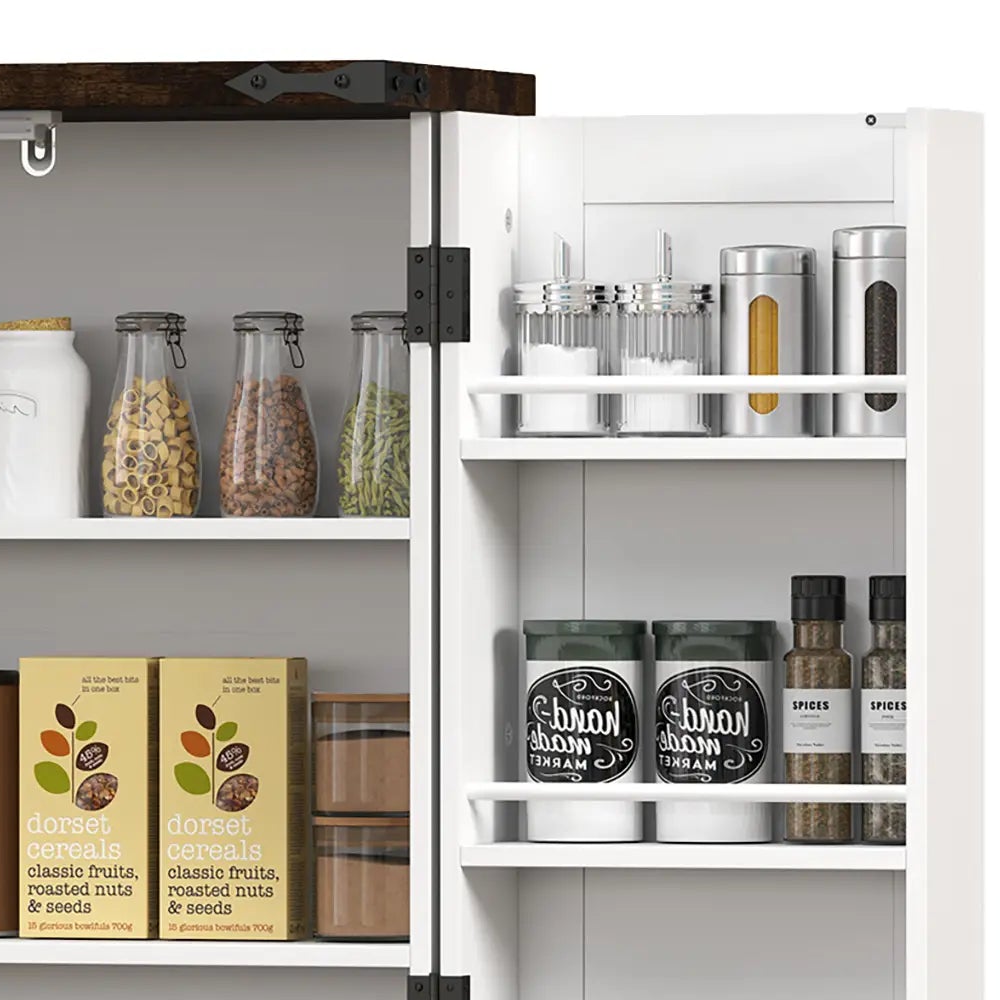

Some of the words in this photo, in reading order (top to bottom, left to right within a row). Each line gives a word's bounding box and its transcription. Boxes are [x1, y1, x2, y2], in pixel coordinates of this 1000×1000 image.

[82, 676, 92, 684] all
[93, 676, 106, 684] the
[108, 676, 123, 684] best
[124, 676, 140, 684] bits
[222, 686, 230, 694] in
[232, 686, 246, 694] one
[247, 686, 261, 694] box
[792, 700, 830, 711] SPICES
[870, 700, 906, 711] SPICES
[26, 812, 112, 834] dorset
[167, 814, 252, 836] dorset
[26, 838, 122, 860] cereals
[167, 840, 262, 861] cereals
[28, 864, 84, 880] classic
[88, 864, 139, 880] fruits,
[168, 865, 224, 881] classic
[228, 865, 280, 881] fruits,
[28, 882, 90, 896] roasted
[94, 882, 133, 896] nuts
[168, 884, 230, 898] roasted
[236, 884, 274, 898] nuts
[28, 899, 42, 913] &
[46, 899, 92, 913] seeds
[168, 900, 182, 914] &
[186, 900, 232, 914] seeds
[112, 922, 133, 932] 700g
[252, 923, 274, 932] 700g
